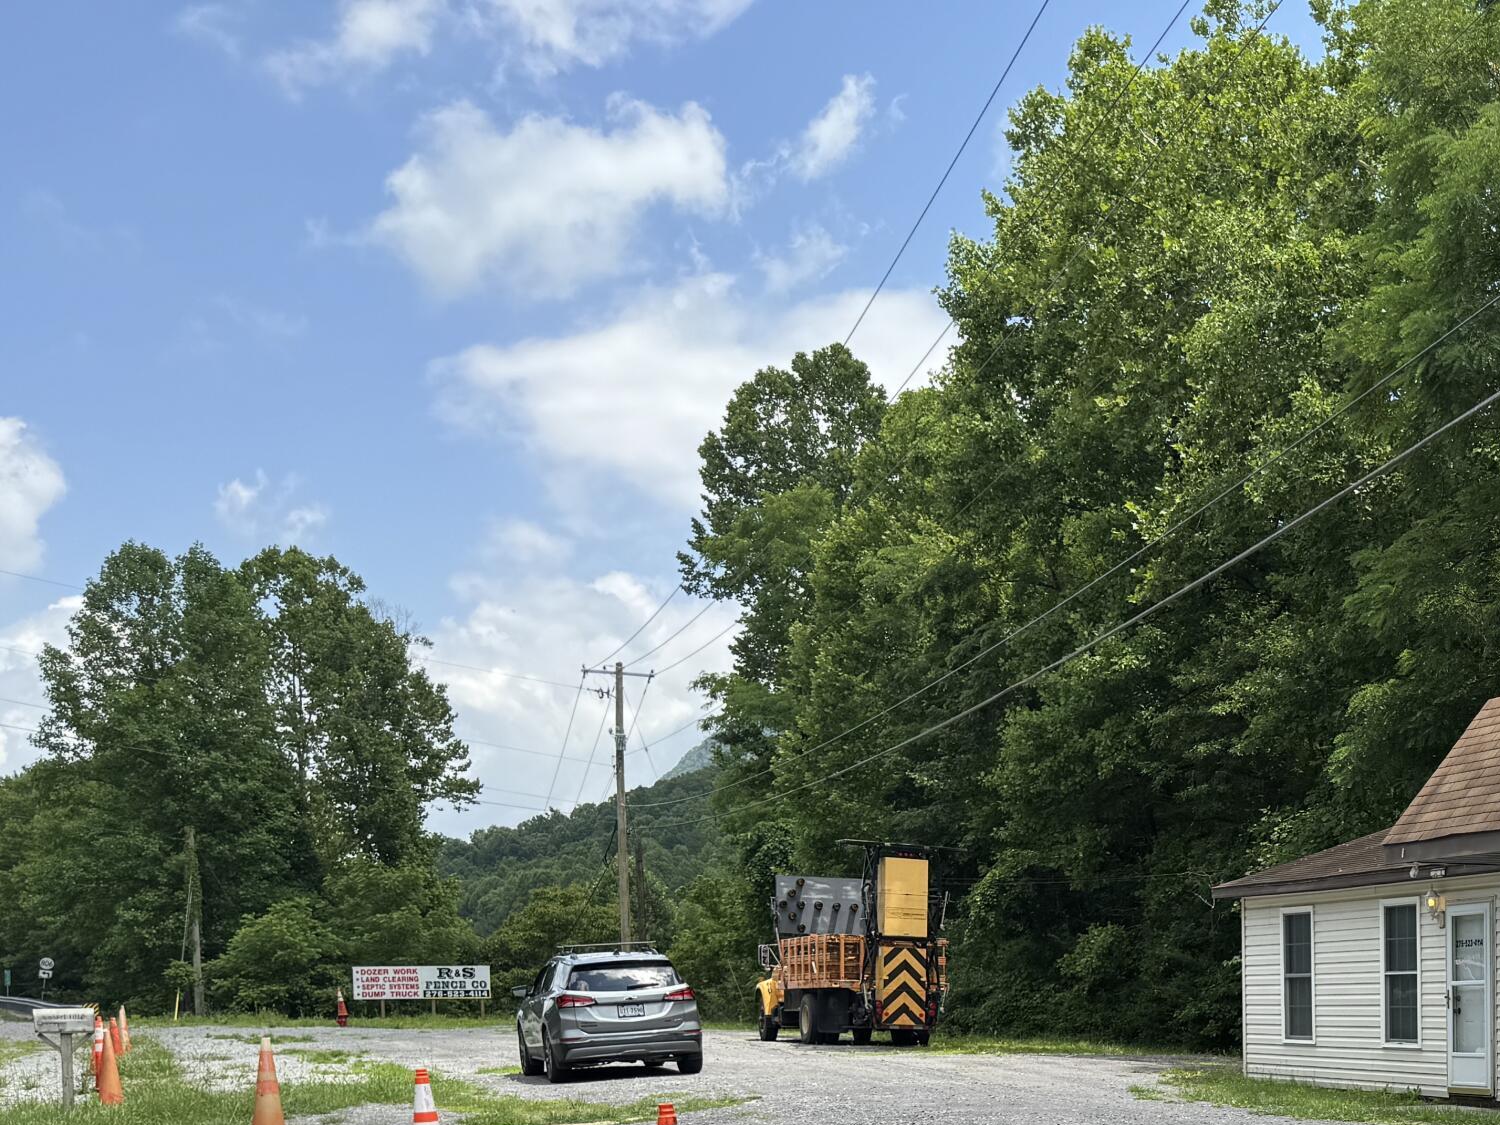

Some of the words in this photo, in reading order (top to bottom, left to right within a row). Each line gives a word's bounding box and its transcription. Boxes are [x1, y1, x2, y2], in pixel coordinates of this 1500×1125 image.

[360, 968, 389, 976] DOZER
[436, 967, 476, 979] R&S
[425, 980, 466, 989] FENCE
[471, 980, 487, 989] CO
